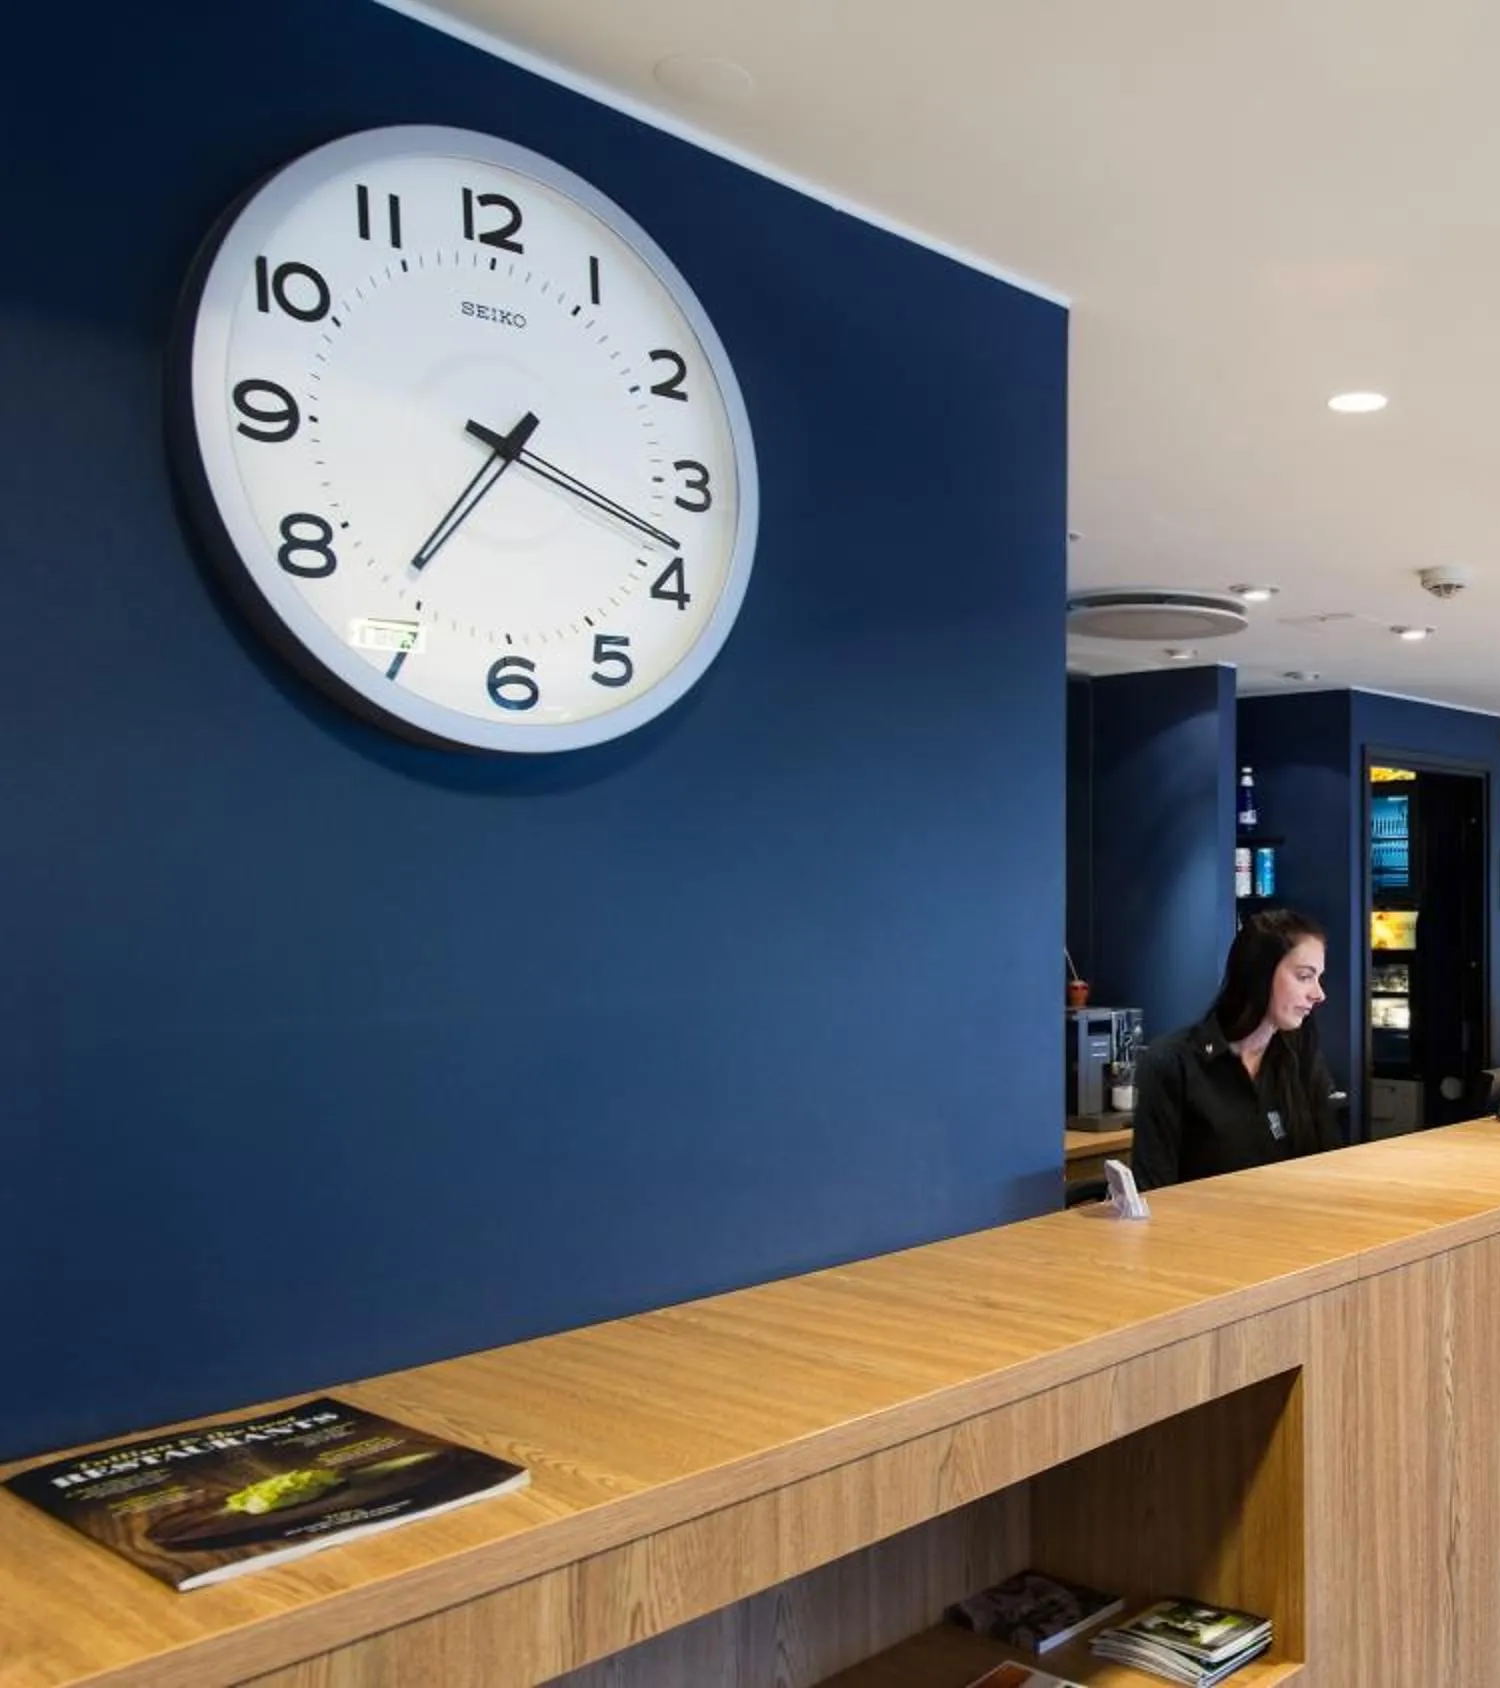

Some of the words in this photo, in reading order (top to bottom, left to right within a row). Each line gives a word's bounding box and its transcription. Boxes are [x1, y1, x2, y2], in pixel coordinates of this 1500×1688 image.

[356, 183, 402, 249] 11
[462, 187, 524, 255] 12
[255, 255, 331, 323] 10
[589, 255, 601, 305] 1
[461, 301, 527, 328] SEIKO
[648, 349, 689, 402] 2
[232, 378, 301, 443] 9
[673, 459, 713, 513] 3
[277, 512, 337, 579] 8
[649, 557, 691, 611] 4
[487, 656, 540, 711] 6
[591, 634, 634, 687] 5
